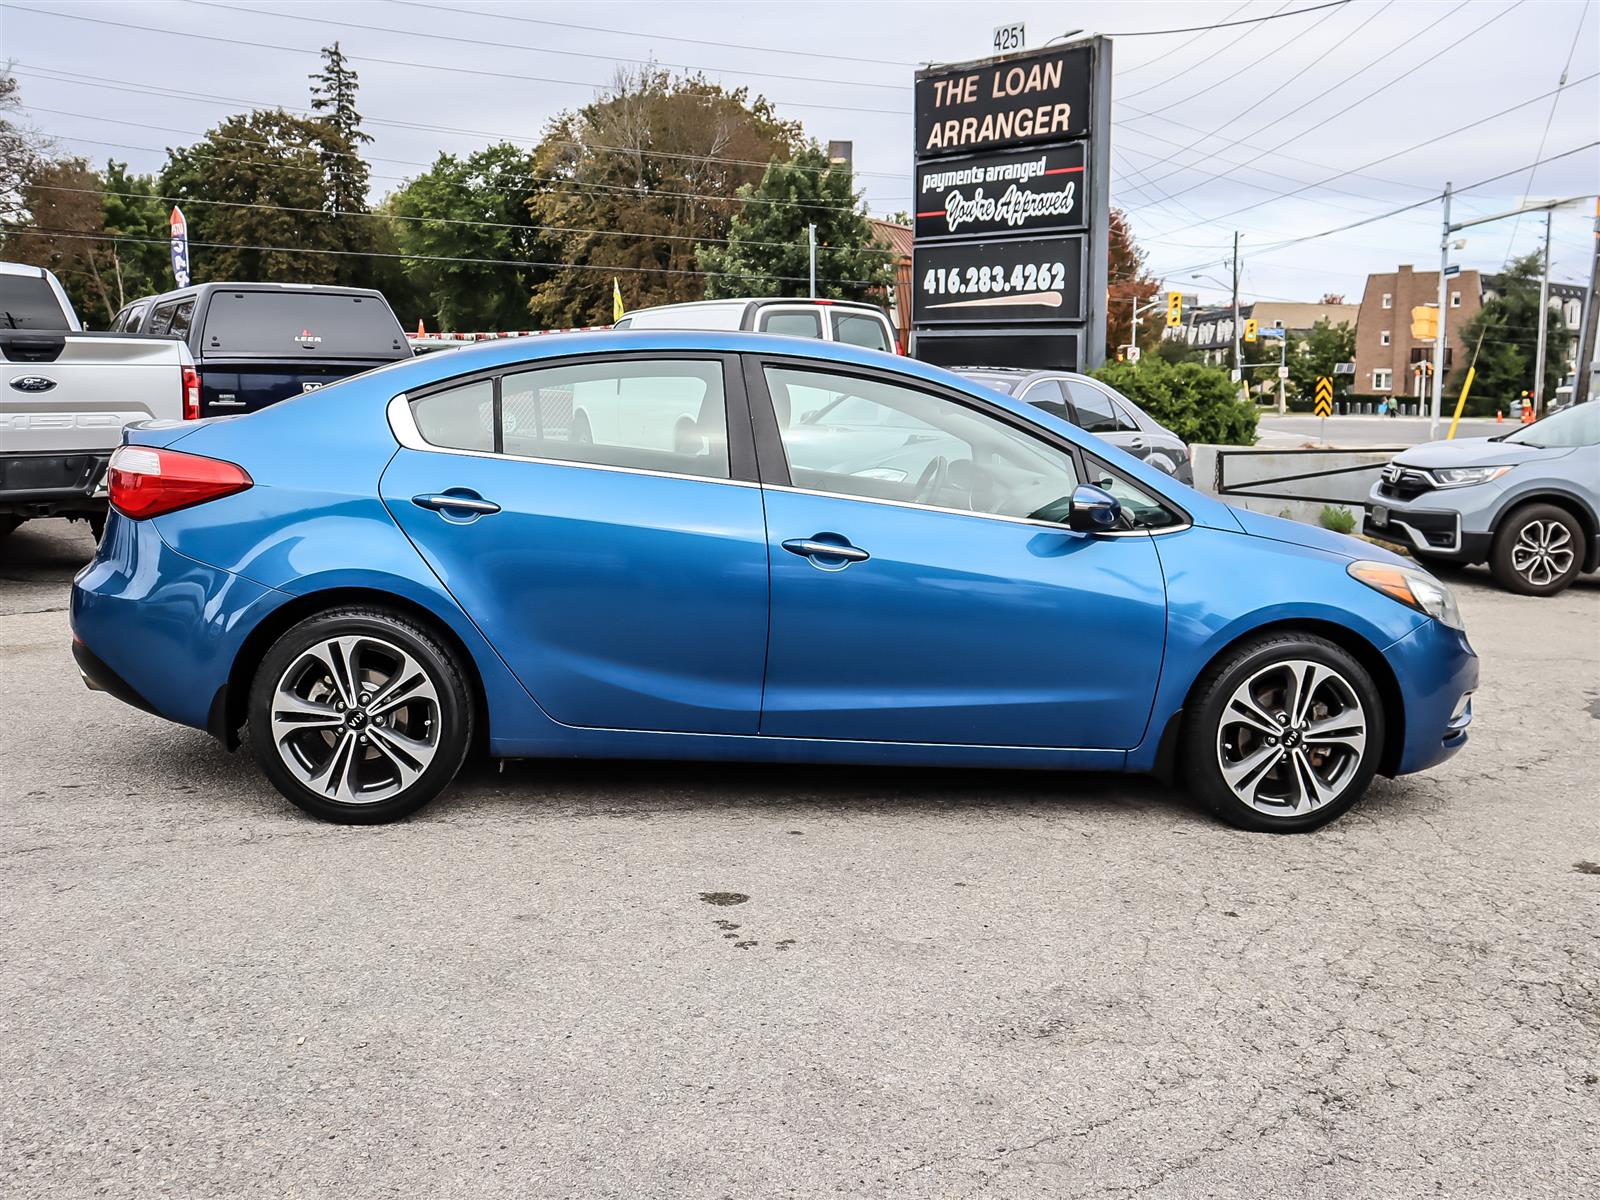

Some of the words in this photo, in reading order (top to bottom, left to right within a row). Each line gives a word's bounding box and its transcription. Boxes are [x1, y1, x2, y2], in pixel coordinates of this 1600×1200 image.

[994, 25, 1025, 50] 4251
[934, 75, 979, 107] THE
[992, 60, 1063, 98] LOAN
[926, 103, 1071, 149] ARRANGER
[922, 166, 984, 193] payments
[985, 156, 1047, 183] arranged
[995, 181, 1075, 226] Approved
[923, 262, 1066, 294] 416.283.4262
[348, 713, 364, 727] KIA
[1285, 731, 1298, 745] KIA
